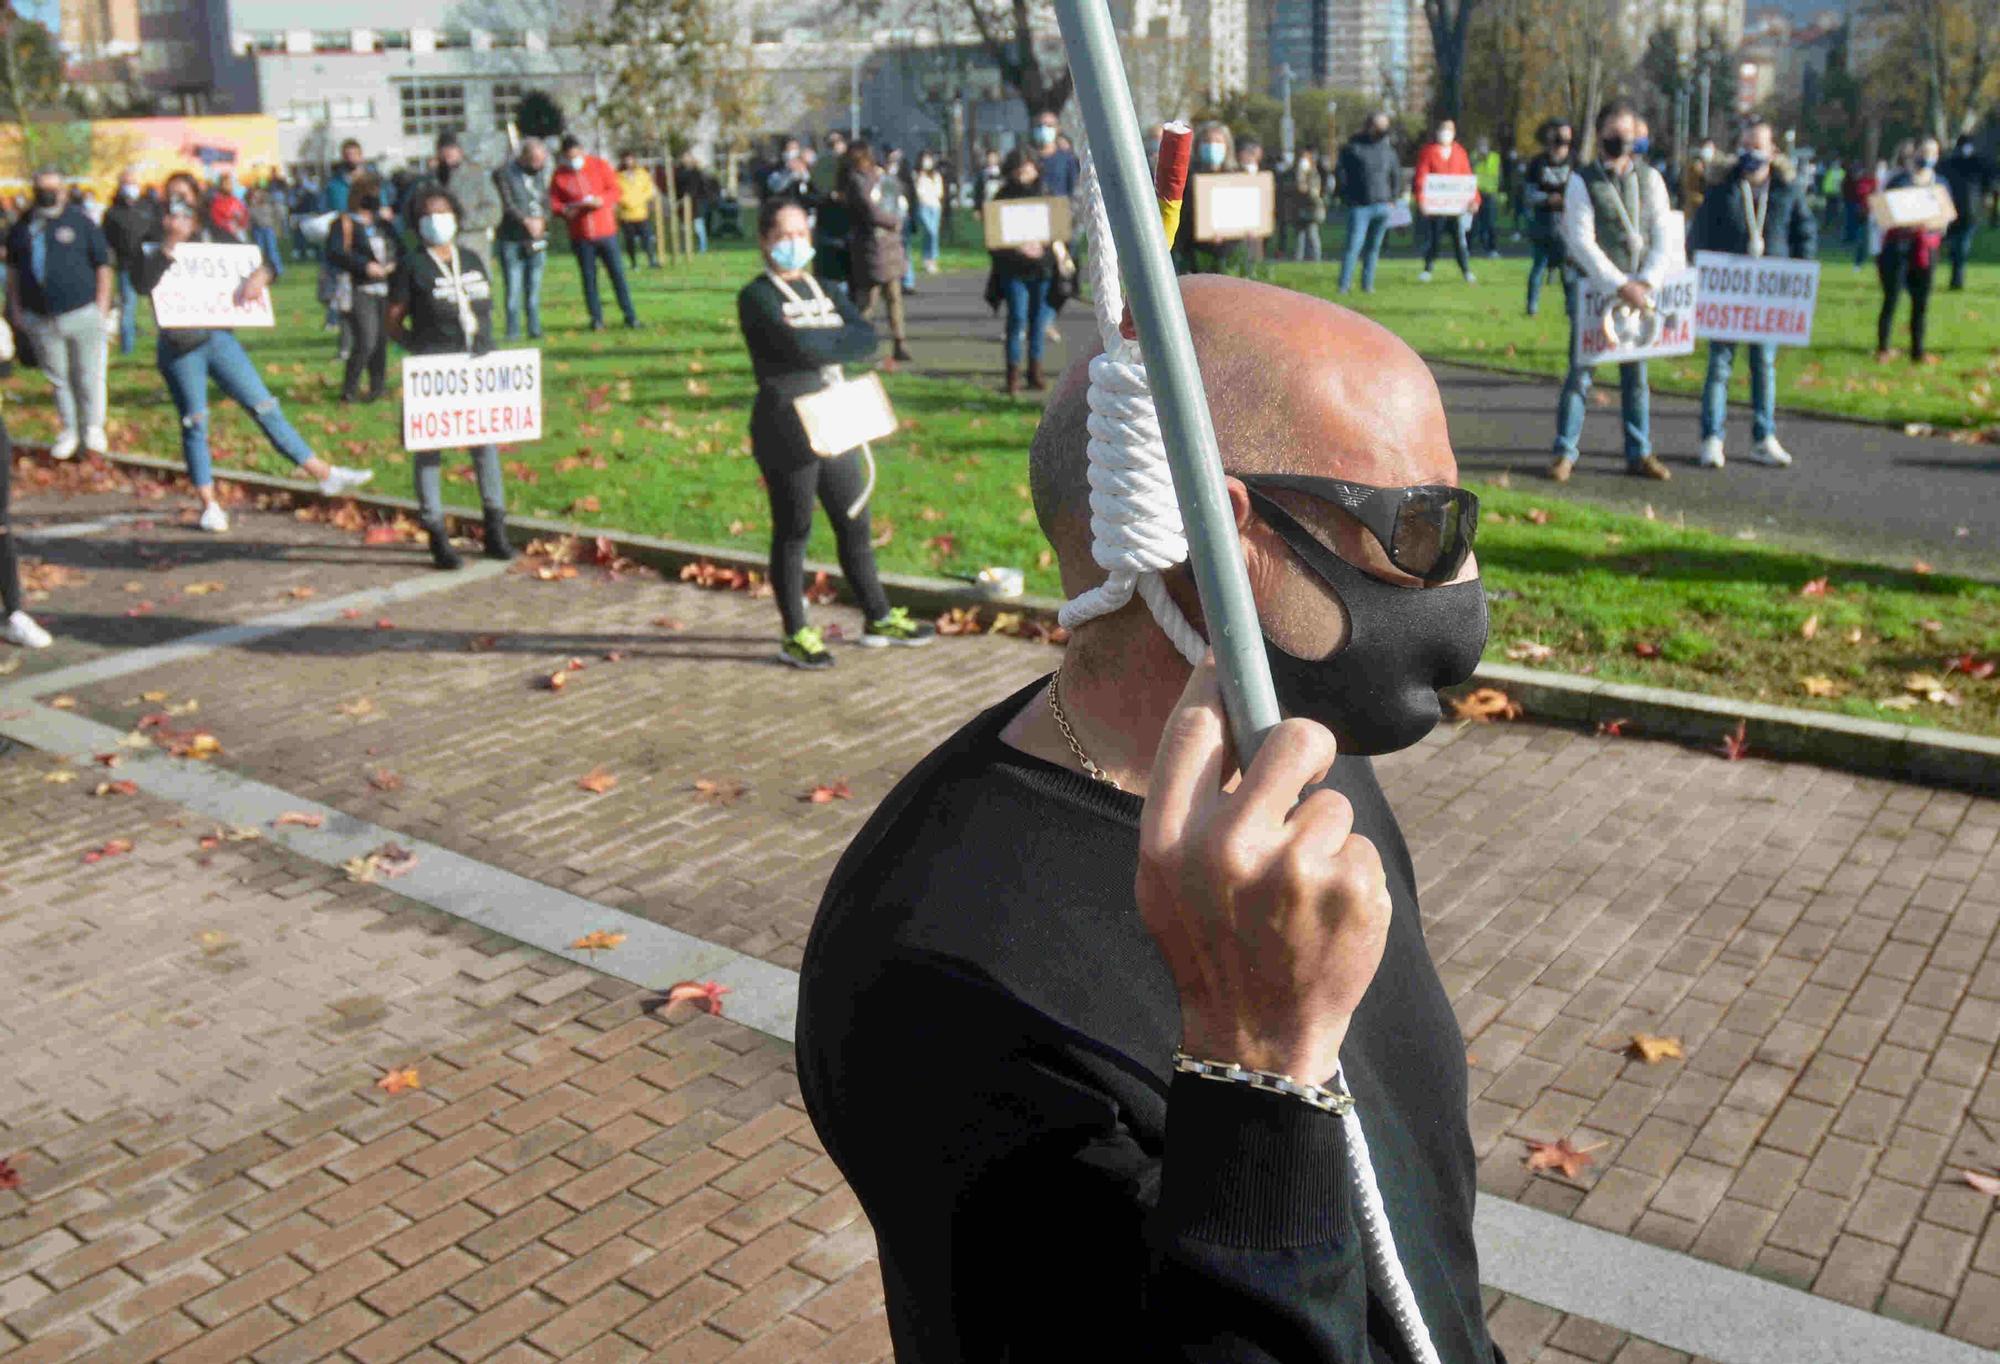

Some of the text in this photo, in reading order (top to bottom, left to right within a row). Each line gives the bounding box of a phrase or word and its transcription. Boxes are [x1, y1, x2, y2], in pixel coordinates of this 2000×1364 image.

[172, 256, 228, 279] OMOS
[1700, 265, 1812, 299] TODOS SOMOS
[409, 363, 534, 397] TODOS SOMOS
[410, 406, 534, 440] HOSTELERIA
